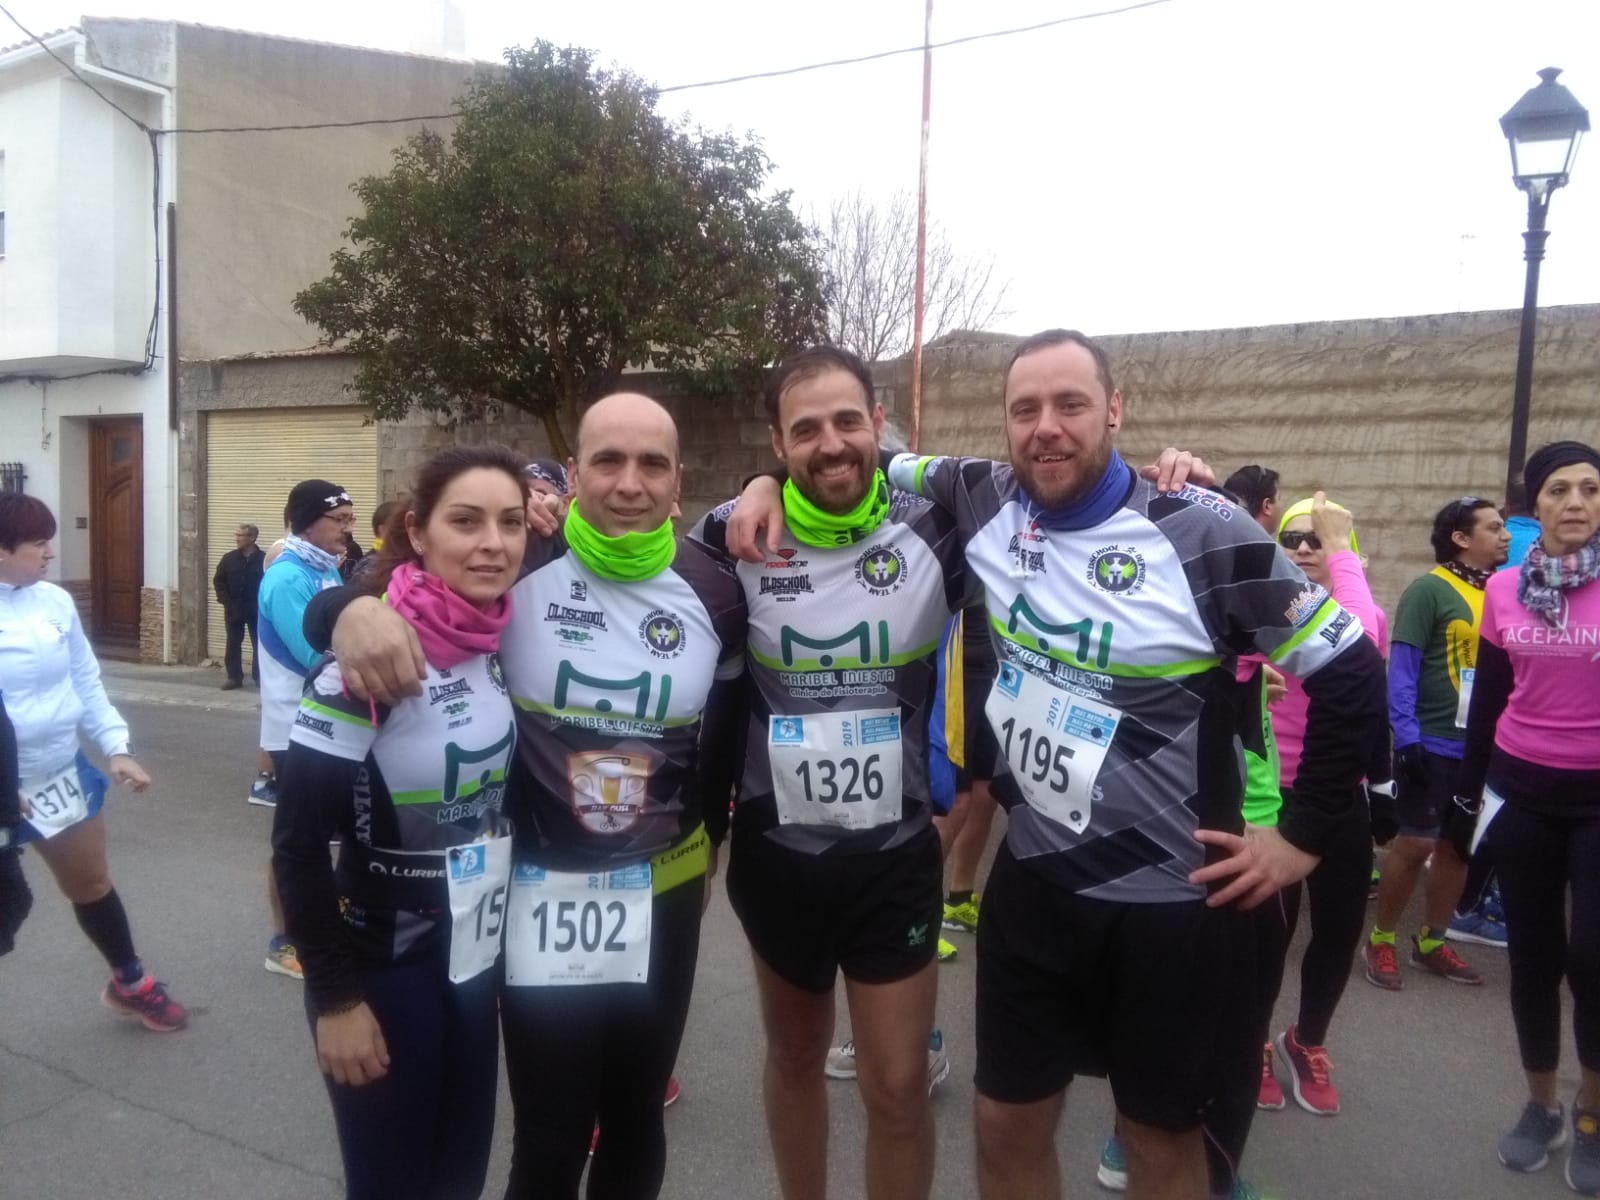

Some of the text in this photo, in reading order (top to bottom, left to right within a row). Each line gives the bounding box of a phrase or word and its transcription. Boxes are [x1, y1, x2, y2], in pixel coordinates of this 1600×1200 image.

[761, 574, 812, 592] OLDSCHOOL
[547, 602, 606, 628] OLDSCHOOL
[779, 668, 896, 687] MARIBEL INIESTA
[820, 686, 833, 699] de
[833, 683, 888, 697] Fisioterapia
[1046, 696, 1061, 727] 2019
[842, 720, 853, 746] 2019
[1001, 716, 1076, 794] 1195
[795, 754, 884, 804] 1326
[532, 900, 627, 953] 1502
